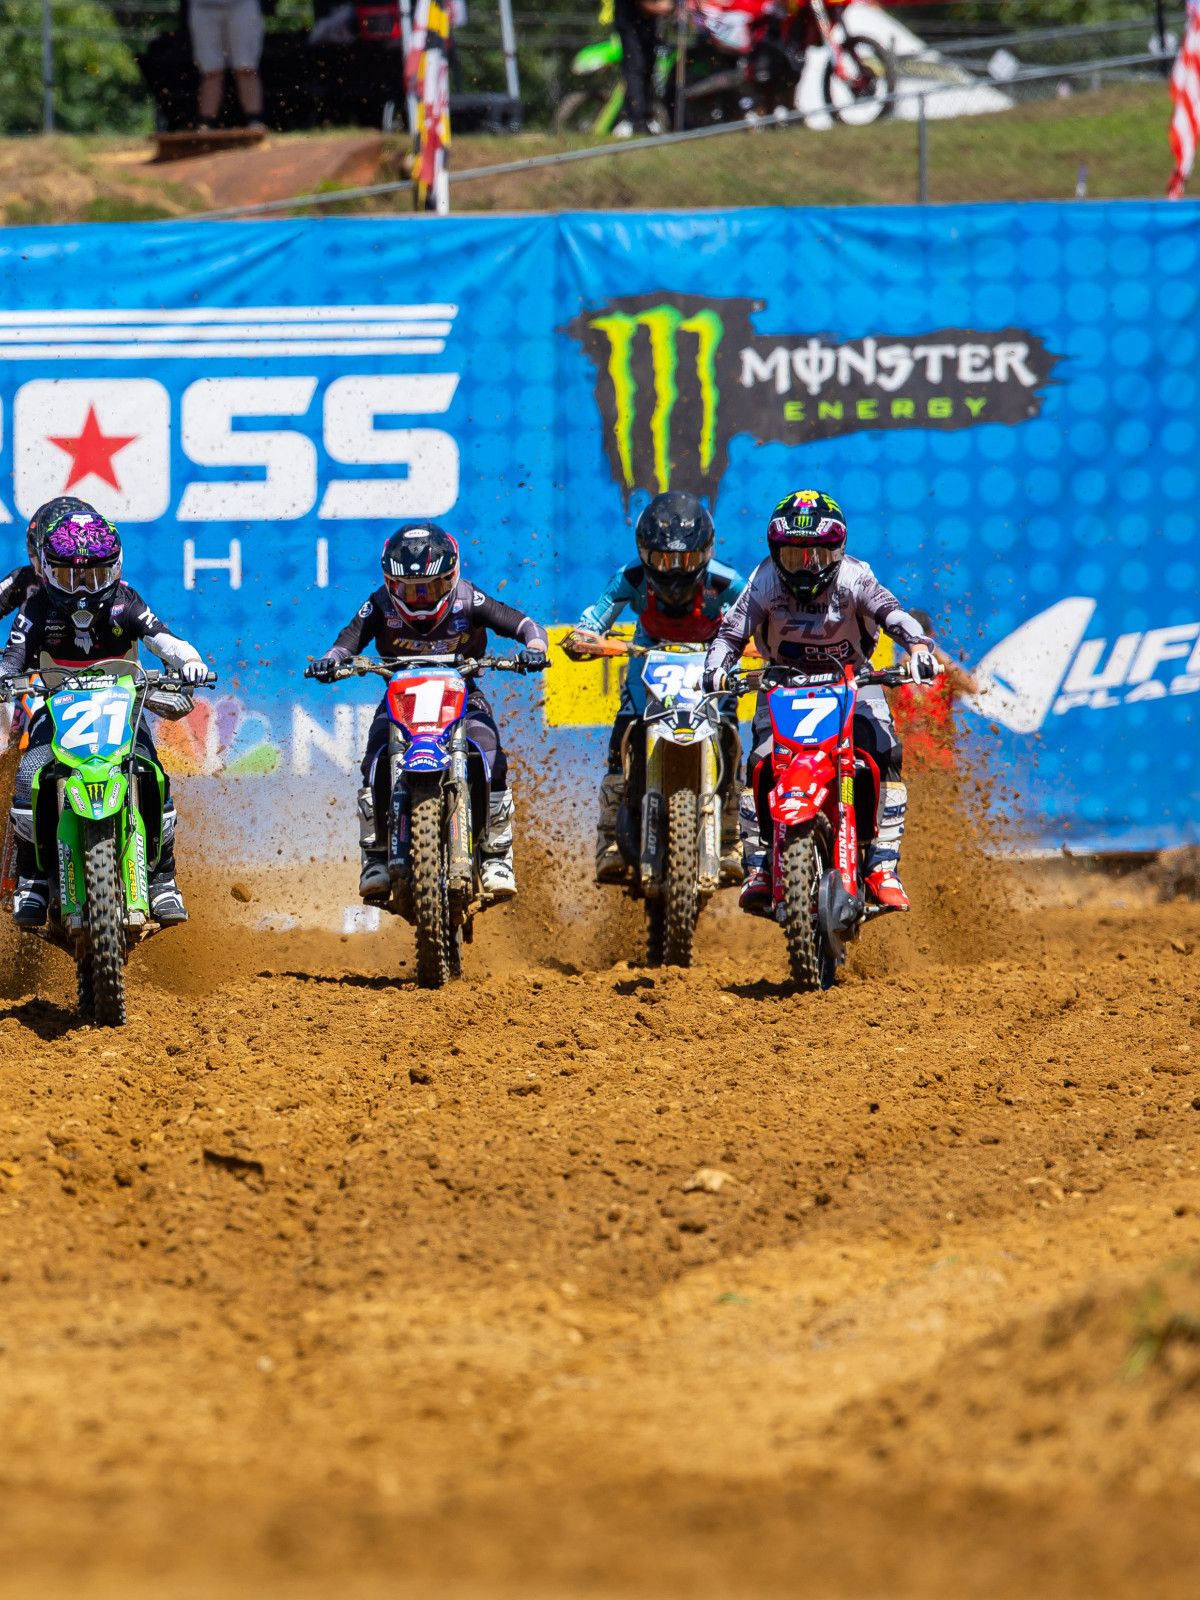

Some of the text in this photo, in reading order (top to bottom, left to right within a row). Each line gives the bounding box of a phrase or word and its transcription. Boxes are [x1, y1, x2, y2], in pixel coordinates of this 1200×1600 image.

[739, 337, 1038, 396] MONSTER
[784, 396, 987, 421] ENERGY
[779, 619, 844, 640] FLY
[54, 696, 74, 705] WMX
[160, 683, 181, 691] ASV
[404, 680, 446, 724] 1
[60, 699, 128, 750] 21
[791, 697, 838, 738] 7
[408, 758, 439, 768] YAMAHA
[58, 839, 68, 906] DUNLOP
[135, 831, 148, 904] DUNLOP
